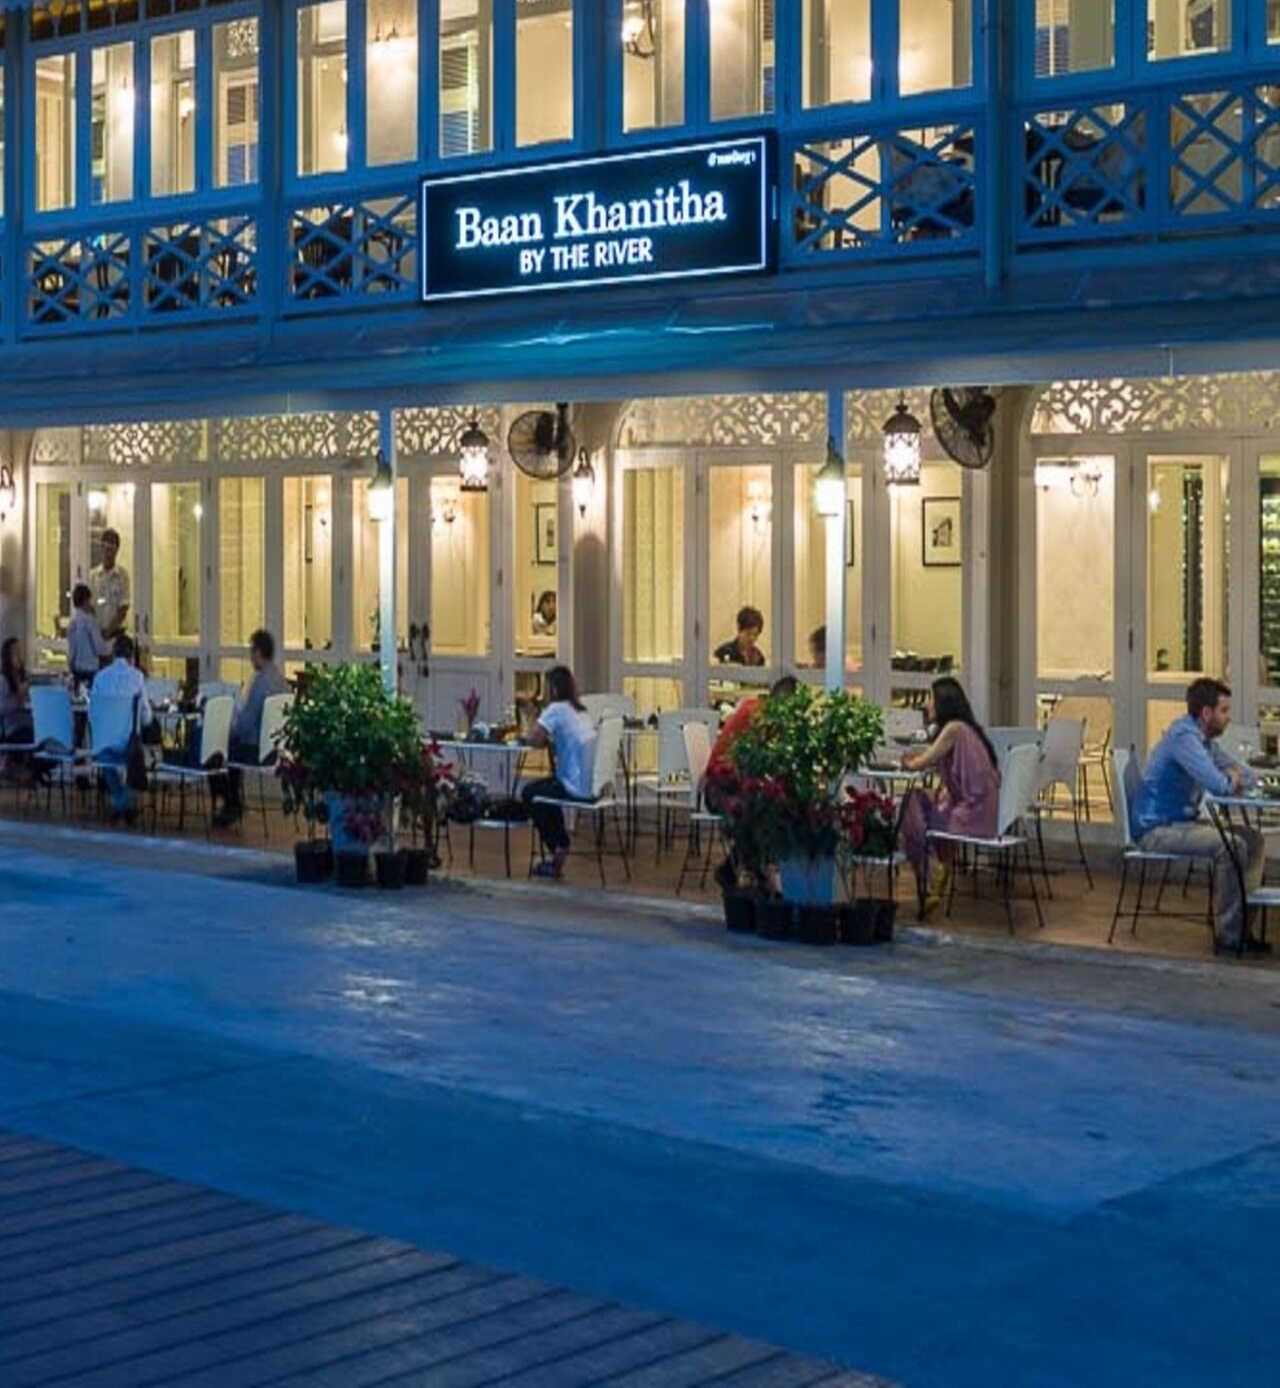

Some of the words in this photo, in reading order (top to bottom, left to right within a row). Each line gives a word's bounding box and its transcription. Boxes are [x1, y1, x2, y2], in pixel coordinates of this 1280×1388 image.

[455, 207, 544, 250] Baan
[553, 179, 727, 239] Khanitha
[519, 249, 546, 275] BY
[551, 243, 590, 271] THE
[594, 236, 654, 269] RIVER
